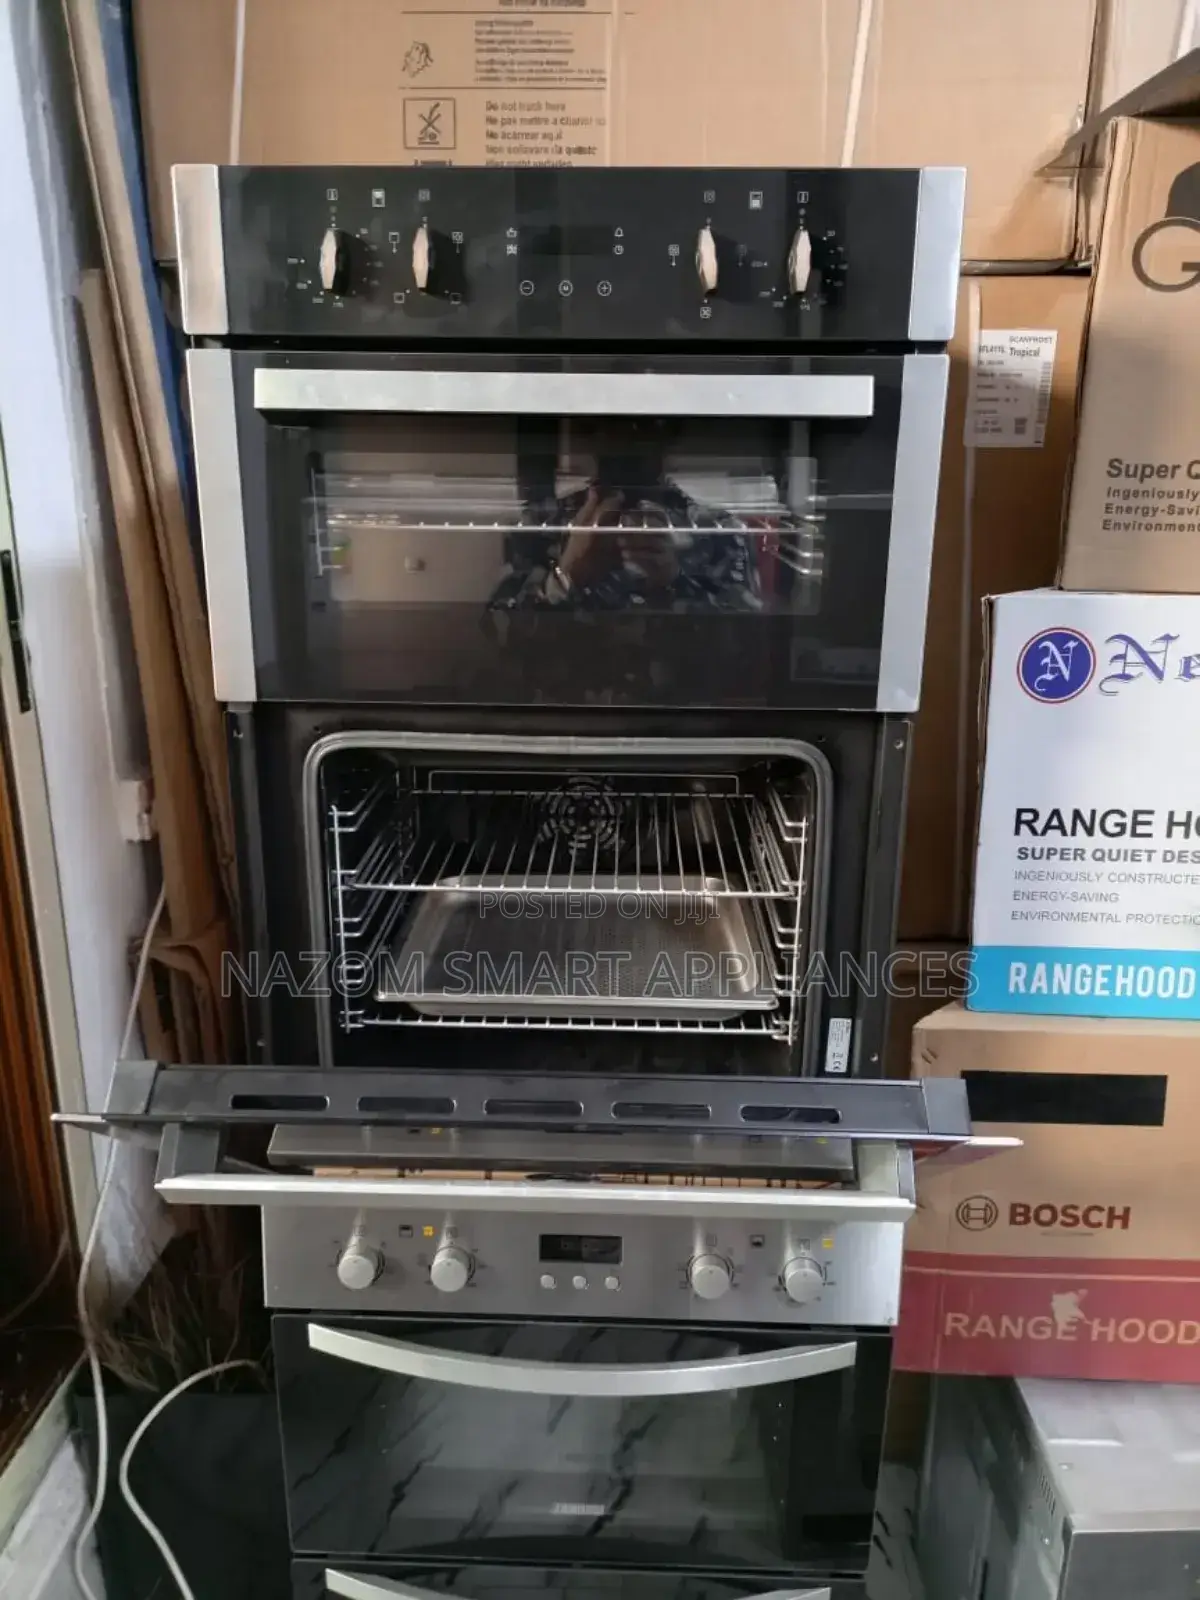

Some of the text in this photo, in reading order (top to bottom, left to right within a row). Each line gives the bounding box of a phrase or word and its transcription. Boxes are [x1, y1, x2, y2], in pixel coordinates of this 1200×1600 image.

[1009, 347, 1040, 357] Tropical
[1106, 458, 1182, 484] Super
[1014, 808, 1200, 839] RANGE H
[1017, 847, 1086, 861] SUPER
[1092, 847, 1157, 863] QUIET
[1014, 870, 1104, 883] INGENIOUSLY
[1013, 890, 1120, 903] ENERGY-SAVING
[1011, 911, 1122, 923] ENVIRONMENTAL
[1009, 1202, 1131, 1230] BOSCH
[945, 1312, 1200, 1345] RANGE HOOD
